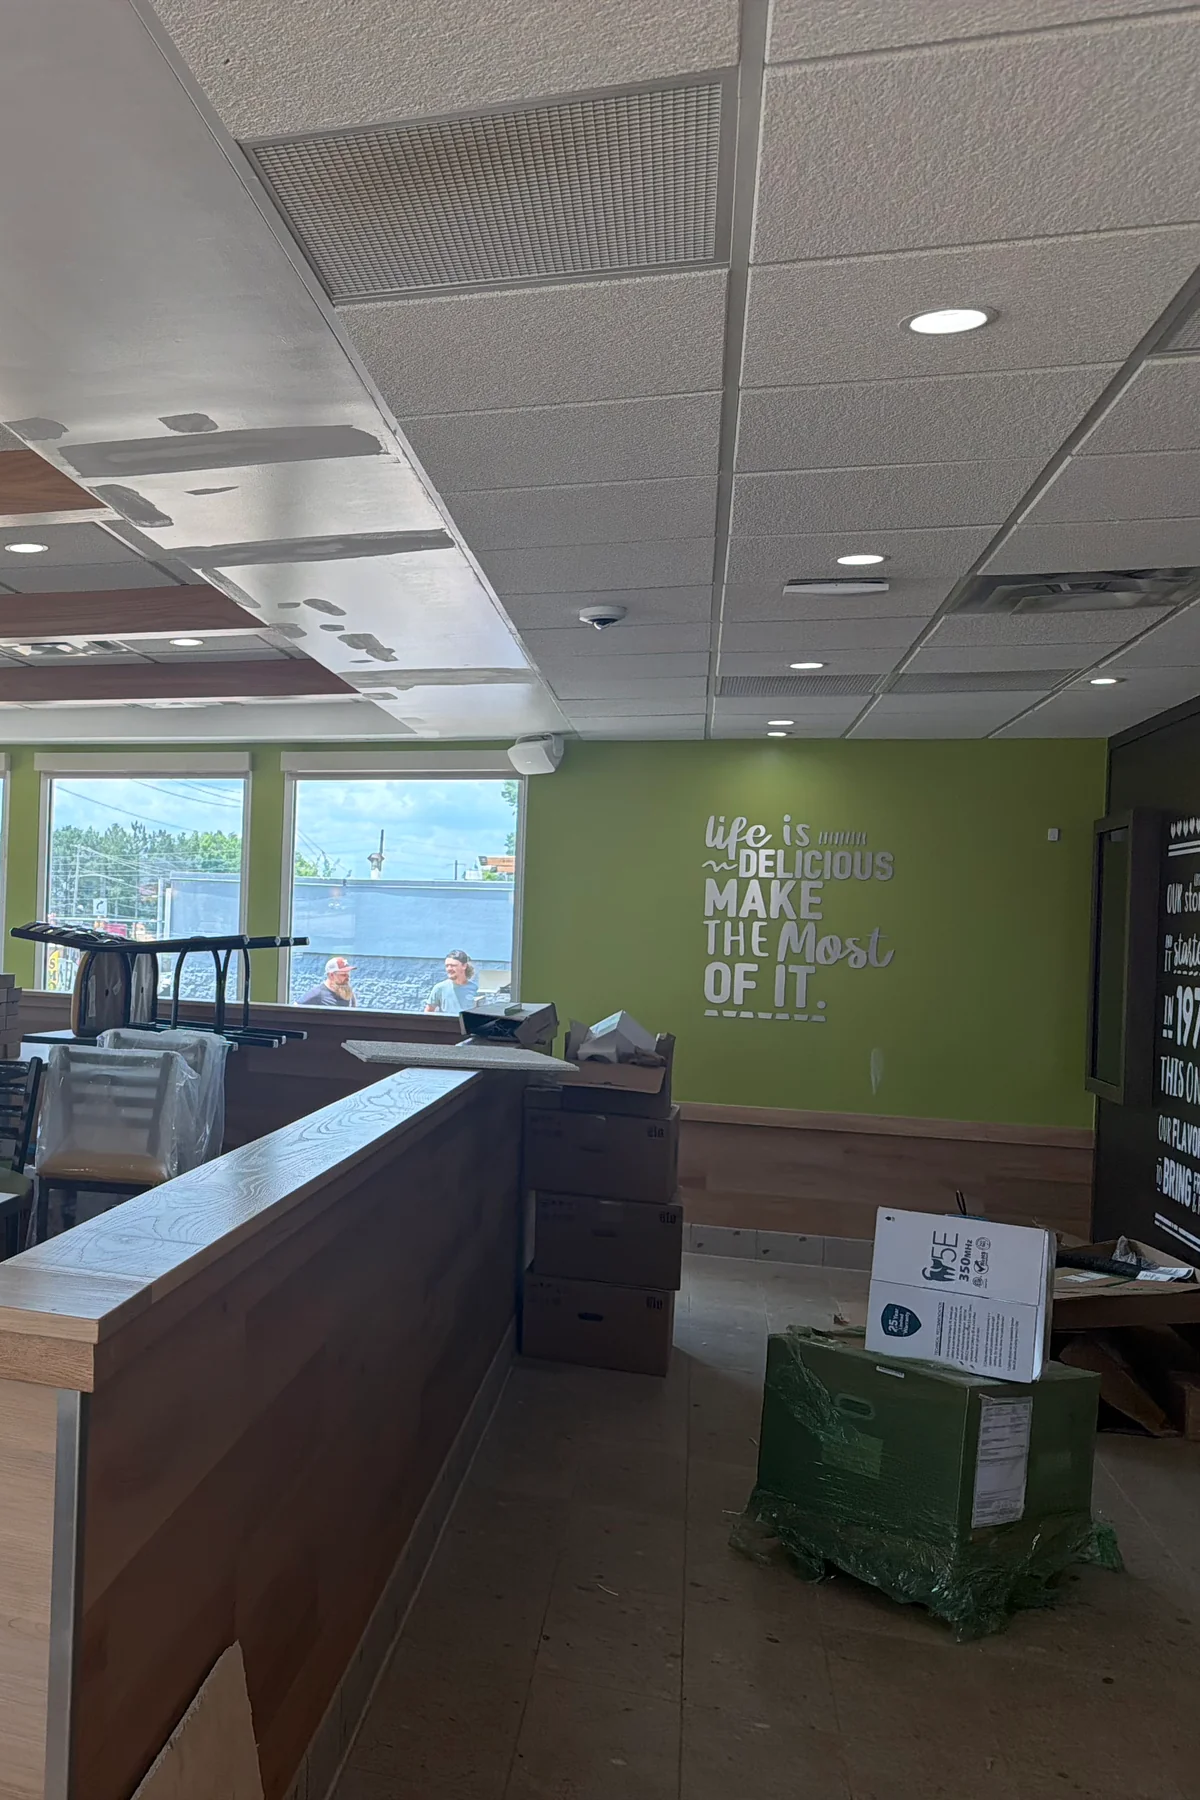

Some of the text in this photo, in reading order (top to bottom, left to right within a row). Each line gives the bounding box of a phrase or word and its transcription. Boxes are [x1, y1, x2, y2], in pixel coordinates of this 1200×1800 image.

[705, 814, 810, 860] life is
[739, 849, 894, 881] DELICIOUS
[704, 878, 824, 920] MAKE
[703, 919, 895, 969] THE Most
[703, 961, 827, 1009] OF IT.
[1163, 995, 1175, 1026] IN
[1160, 1055, 1184, 1098] THIS
[1158, 1114, 1171, 1146] OUR
[1162, 1156, 1192, 1208] BRING
[959, 1238, 973, 1282] 350MHz
[888, 1319, 898, 1332] 25
